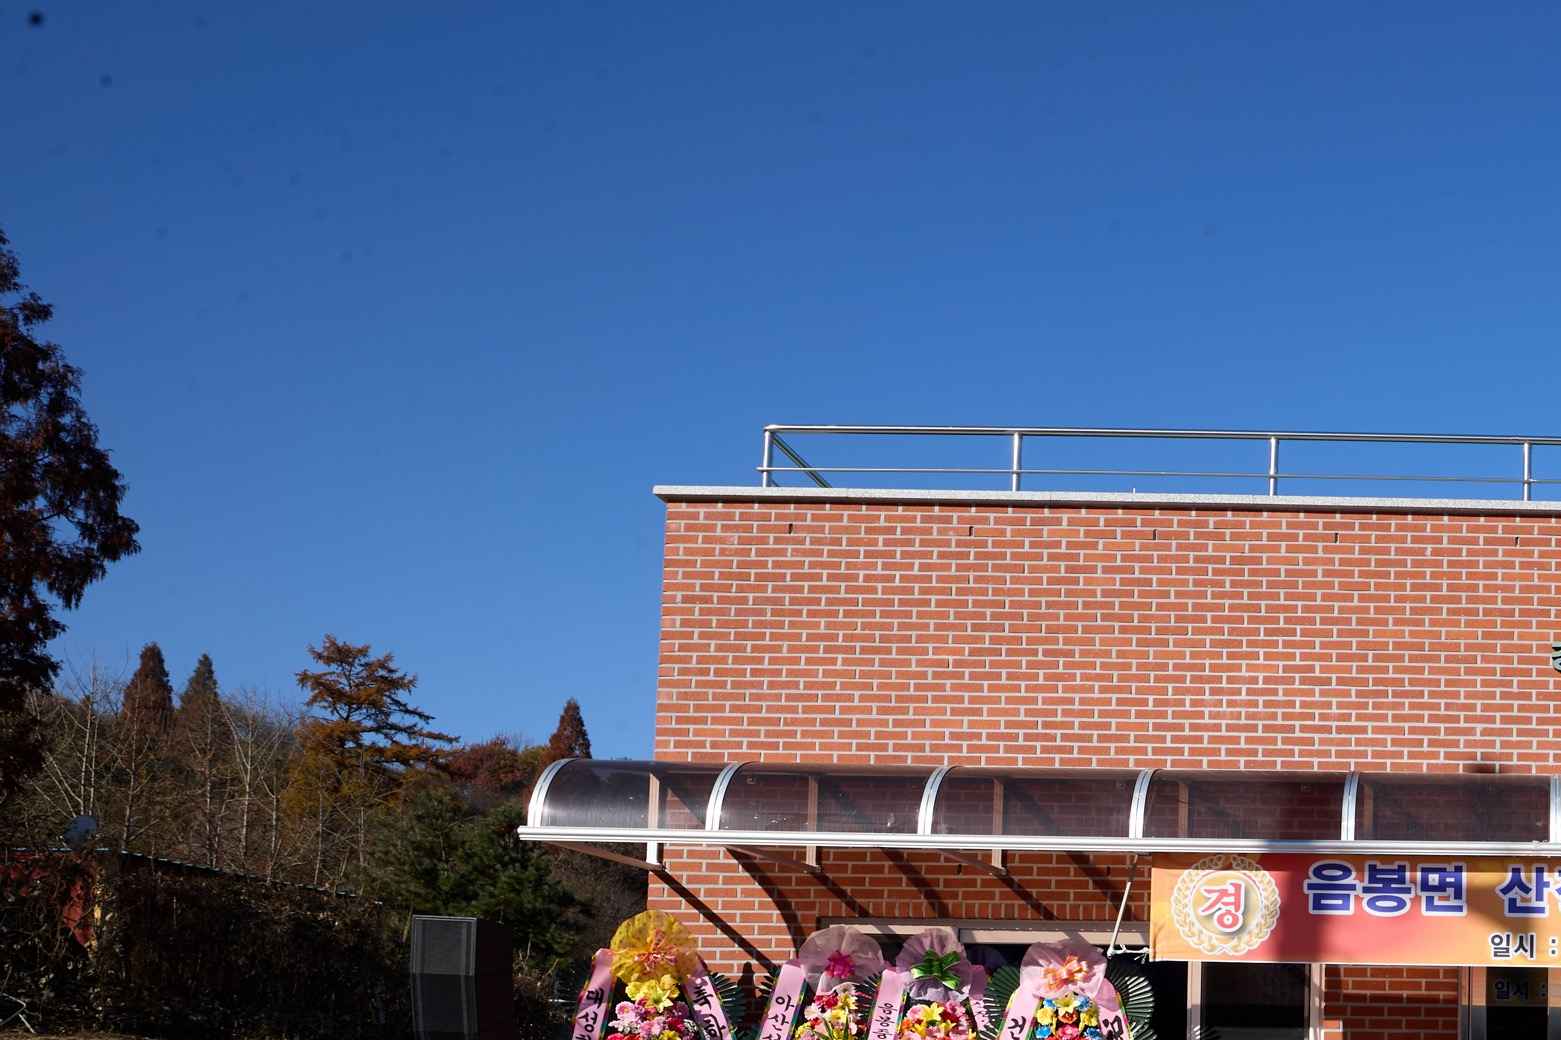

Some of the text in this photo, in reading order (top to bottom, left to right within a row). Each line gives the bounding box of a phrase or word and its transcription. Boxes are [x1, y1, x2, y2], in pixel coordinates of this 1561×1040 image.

[1201, 882, 1243, 931] 경
[1305, 860, 1466, 914] 음봉면
[1490, 934, 1536, 958] 일시
